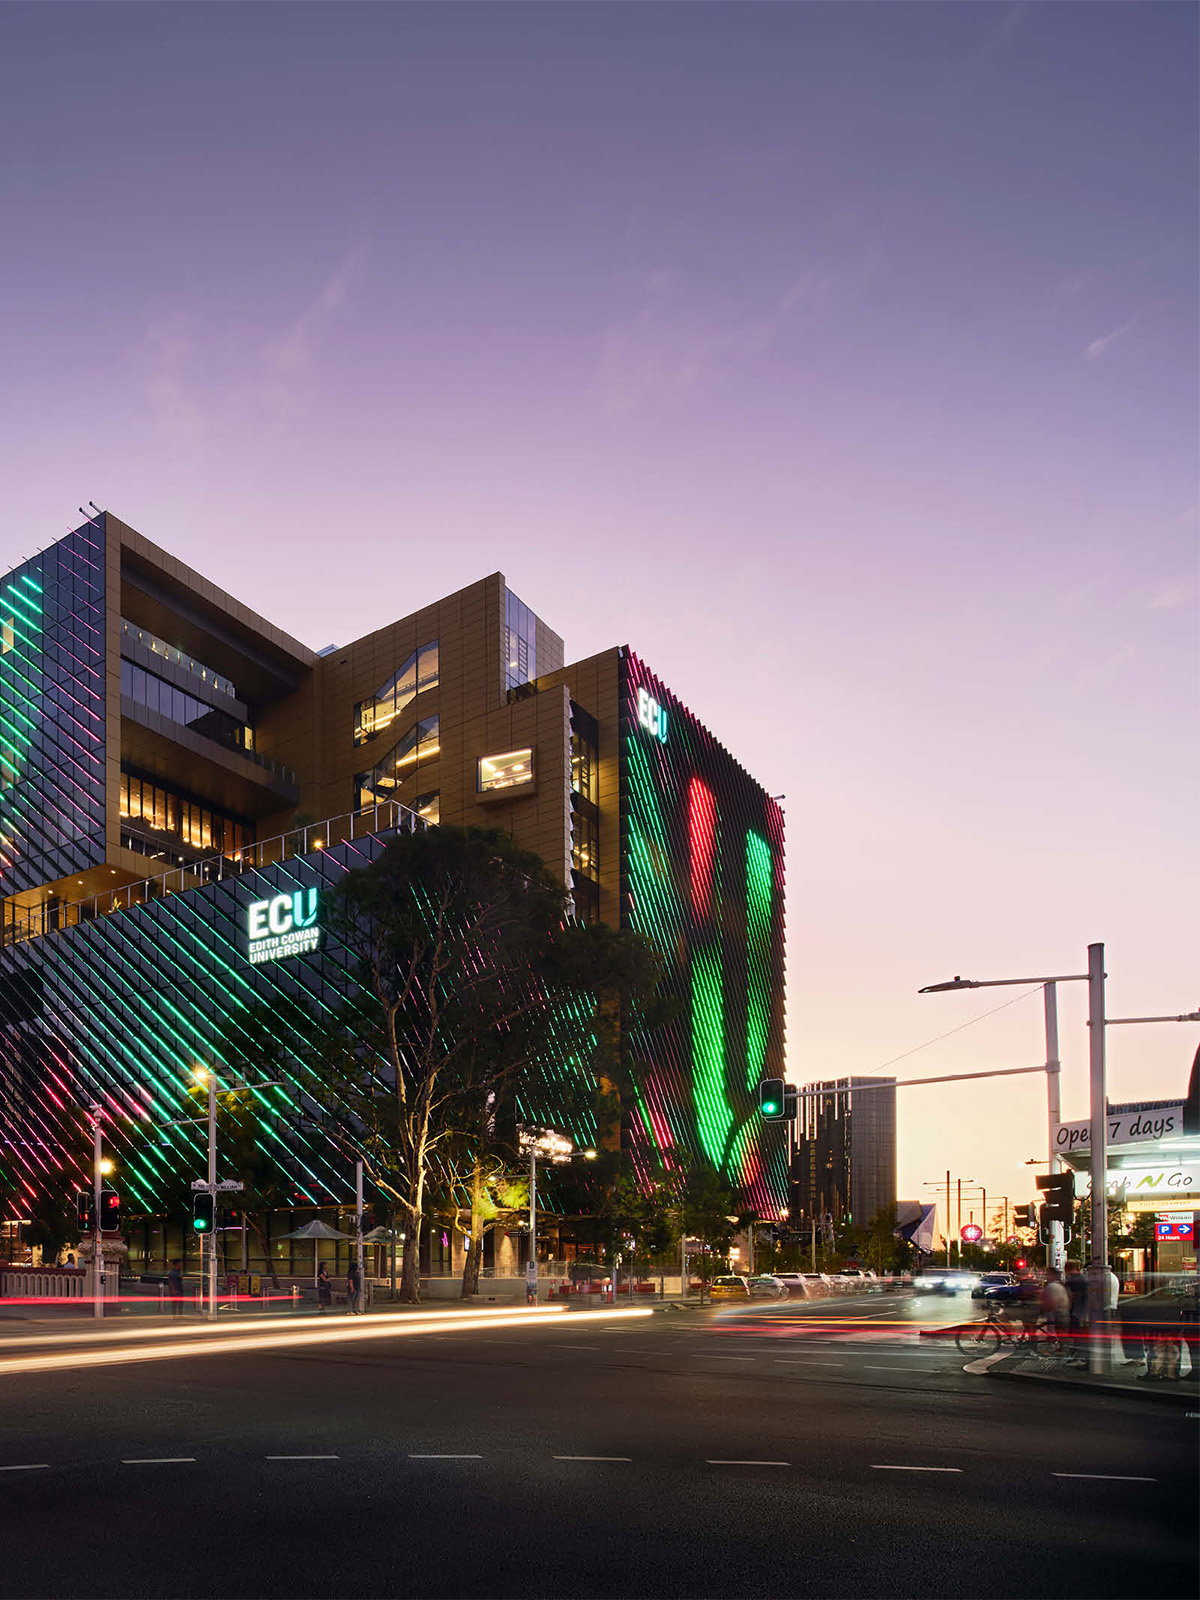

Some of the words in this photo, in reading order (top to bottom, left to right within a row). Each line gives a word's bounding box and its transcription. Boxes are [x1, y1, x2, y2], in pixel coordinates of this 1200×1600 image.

[638, 687, 667, 743] ECU
[249, 887, 317, 940] ECU
[249, 937, 279, 953] EDITH
[281, 927, 319, 945] COWAN
[249, 938, 319, 964] UNIVERSITY
[1056, 1127, 1092, 1149] Ope
[1109, 1122, 1121, 1138] 7
[1129, 1115, 1175, 1139] days
[1167, 1173, 1193, 1188] Go
[1161, 1226, 1170, 1234] P
